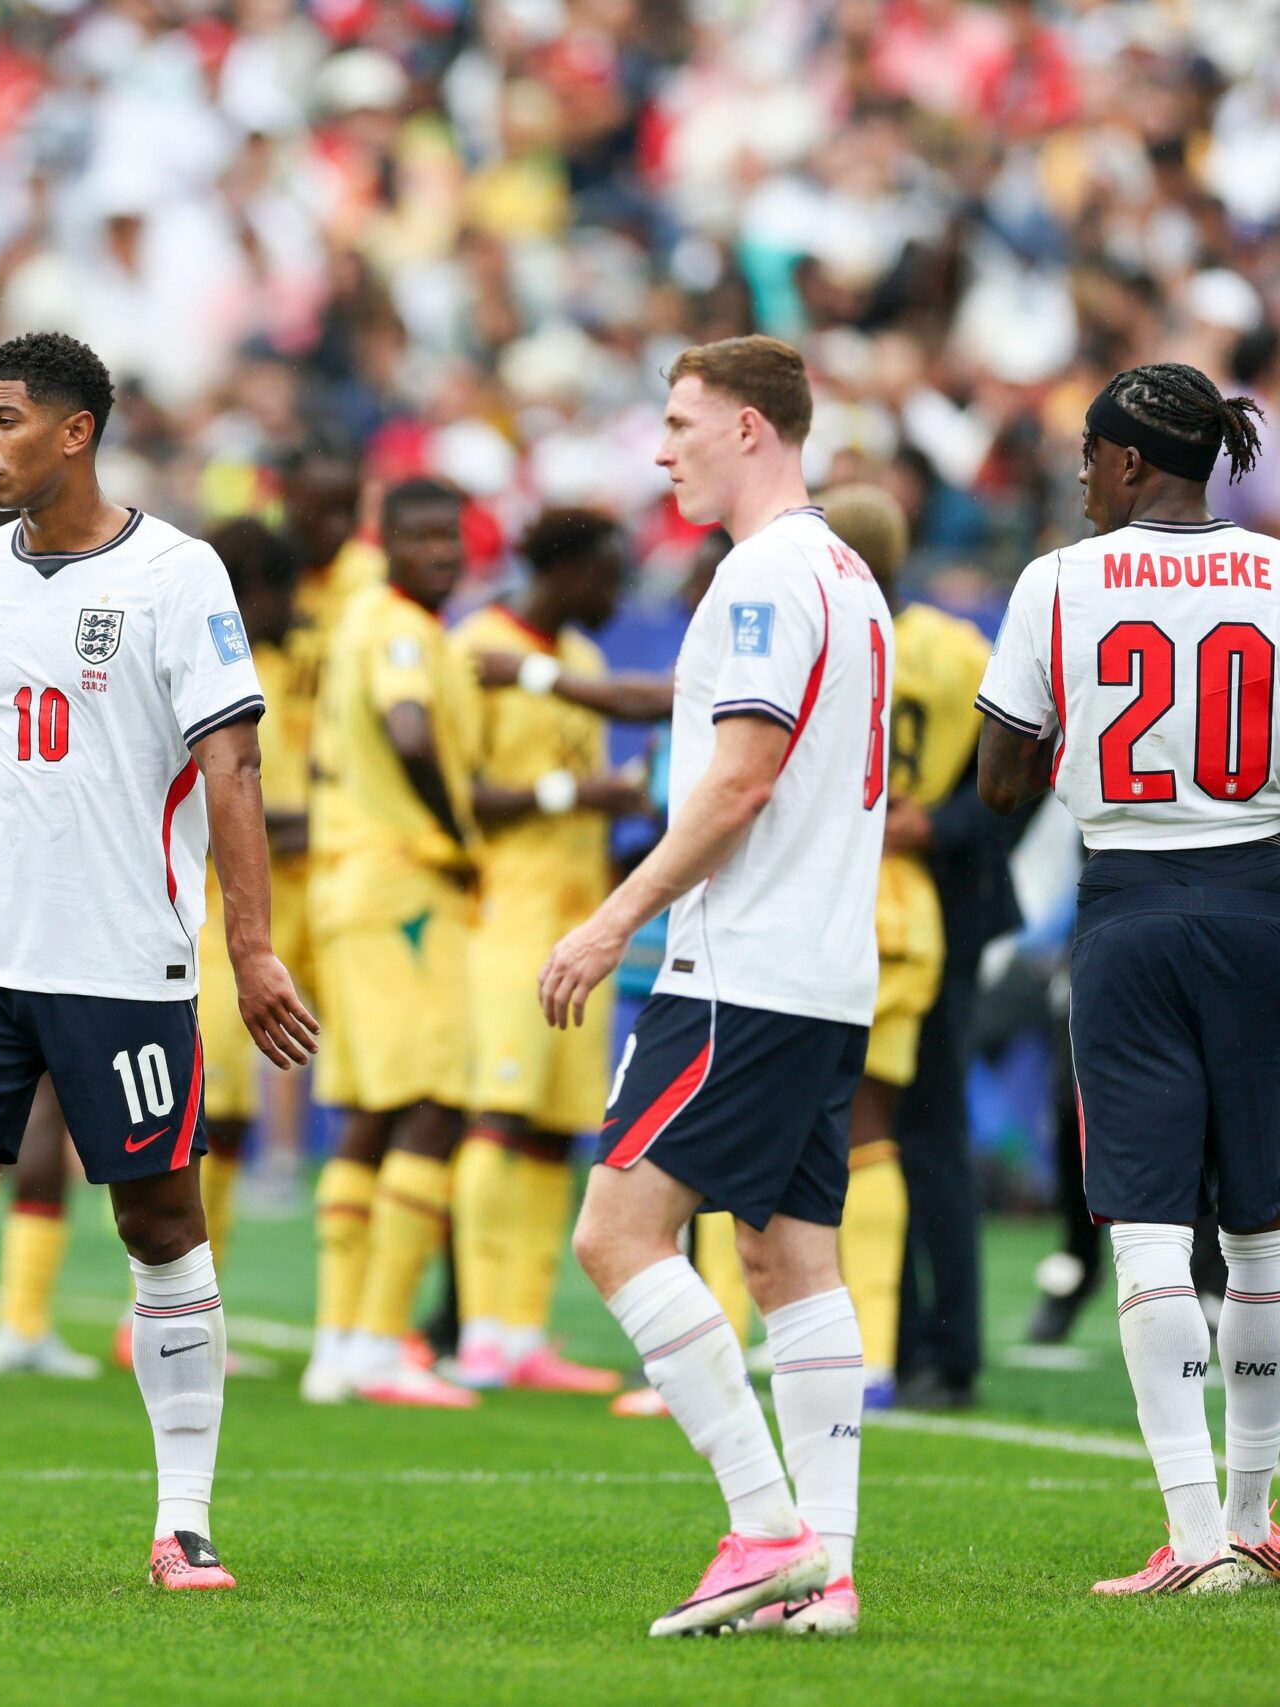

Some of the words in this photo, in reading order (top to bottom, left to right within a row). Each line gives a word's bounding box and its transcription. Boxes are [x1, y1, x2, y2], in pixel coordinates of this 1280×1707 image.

[1104, 552, 1272, 591] MADUEKE
[81, 669, 107, 681] GHANA
[14, 686, 70, 762] 10
[863, 618, 886, 811] 8
[1097, 620, 1276, 803] 20
[112, 1043, 175, 1125] 10
[1182, 1361, 1208, 1378] EN
[1234, 1360, 1278, 1377] ENG
[830, 1424, 861, 1438] EN
